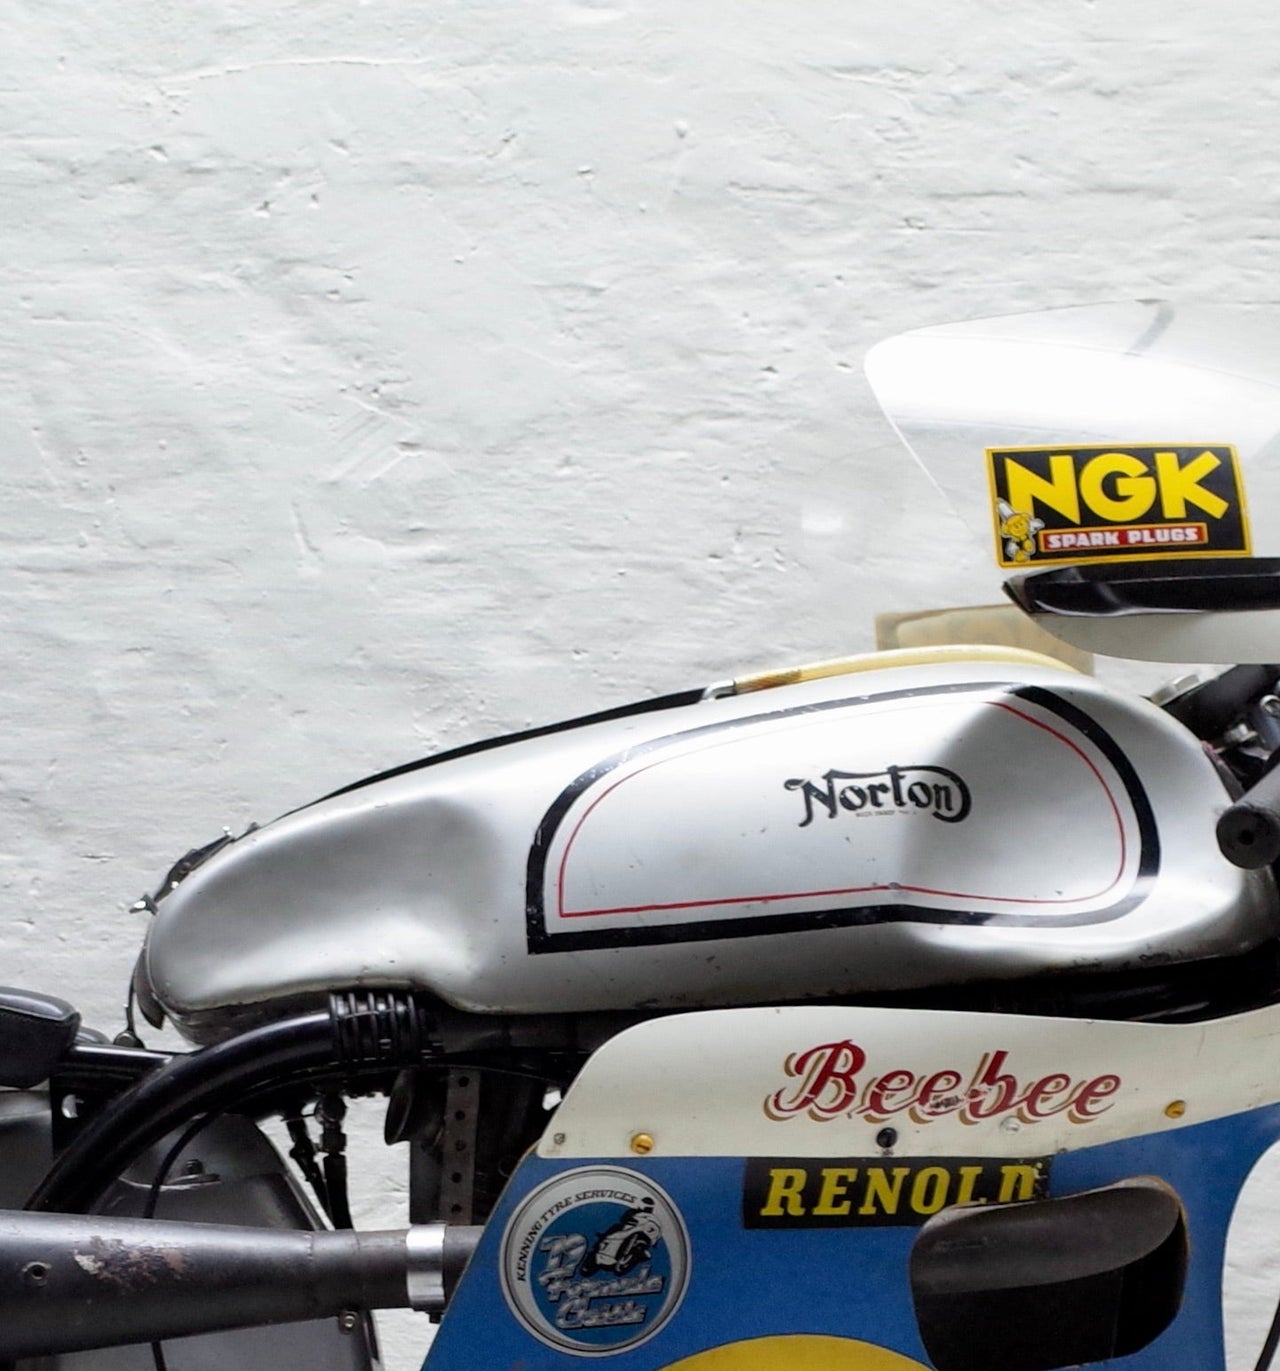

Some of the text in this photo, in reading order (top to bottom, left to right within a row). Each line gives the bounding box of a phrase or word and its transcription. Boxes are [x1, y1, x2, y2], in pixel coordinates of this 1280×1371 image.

[1004, 451, 1229, 525] NGK
[1048, 527, 1198, 550] SPARK PLUGS
[784, 765, 972, 827] Norton
[763, 1039, 1121, 1126] Beebee
[760, 1164, 1035, 1217] RENOLD
[517, 1189, 638, 1282] KENNING TYRE SERVICES
